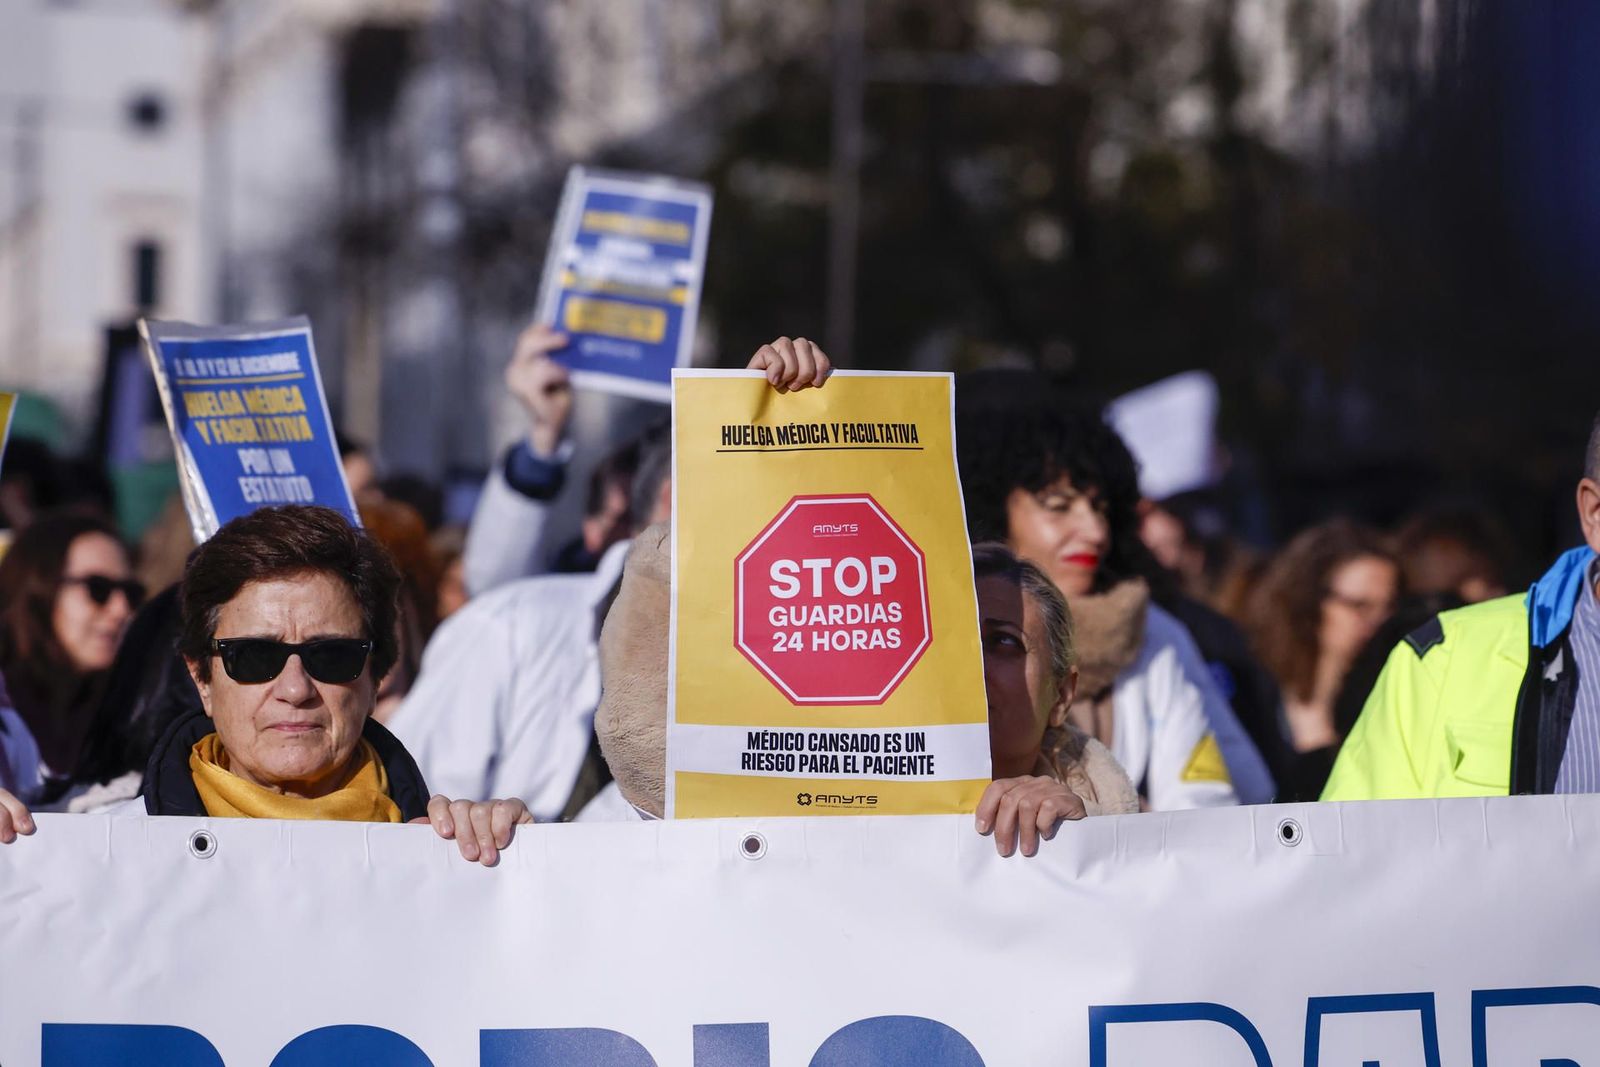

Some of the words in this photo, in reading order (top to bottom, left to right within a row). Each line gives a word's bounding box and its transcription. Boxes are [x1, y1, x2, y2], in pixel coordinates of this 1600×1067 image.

[183, 390, 246, 418] HUELGA
[242, 385, 307, 414] MÉDICA
[195, 420, 212, 445] Y
[210, 415, 313, 444] FACULTATIVA
[722, 425, 775, 446] HUELGA
[776, 422, 830, 446] MÉDICA
[831, 423, 840, 443] Y
[842, 423, 919, 444] FACULTATIVA
[238, 448, 273, 474] POR
[268, 448, 296, 474] UN
[238, 475, 315, 503] ESTATUTO
[813, 524, 858, 533] AMYTS
[769, 556, 897, 599] STOP
[768, 602, 902, 626] GUARDIAS
[772, 631, 804, 652] 24
[812, 628, 902, 651] HORAS
[747, 730, 804, 752] MÉDICO
[808, 732, 880, 753] CANSADO
[884, 733, 902, 753] ES
[905, 732, 925, 753] UN
[741, 752, 795, 772] RIESGO
[799, 754, 840, 773] PARA
[843, 755, 859, 774] EL
[863, 755, 935, 775] PACIENTE
[815, 794, 878, 804] AMYTS
